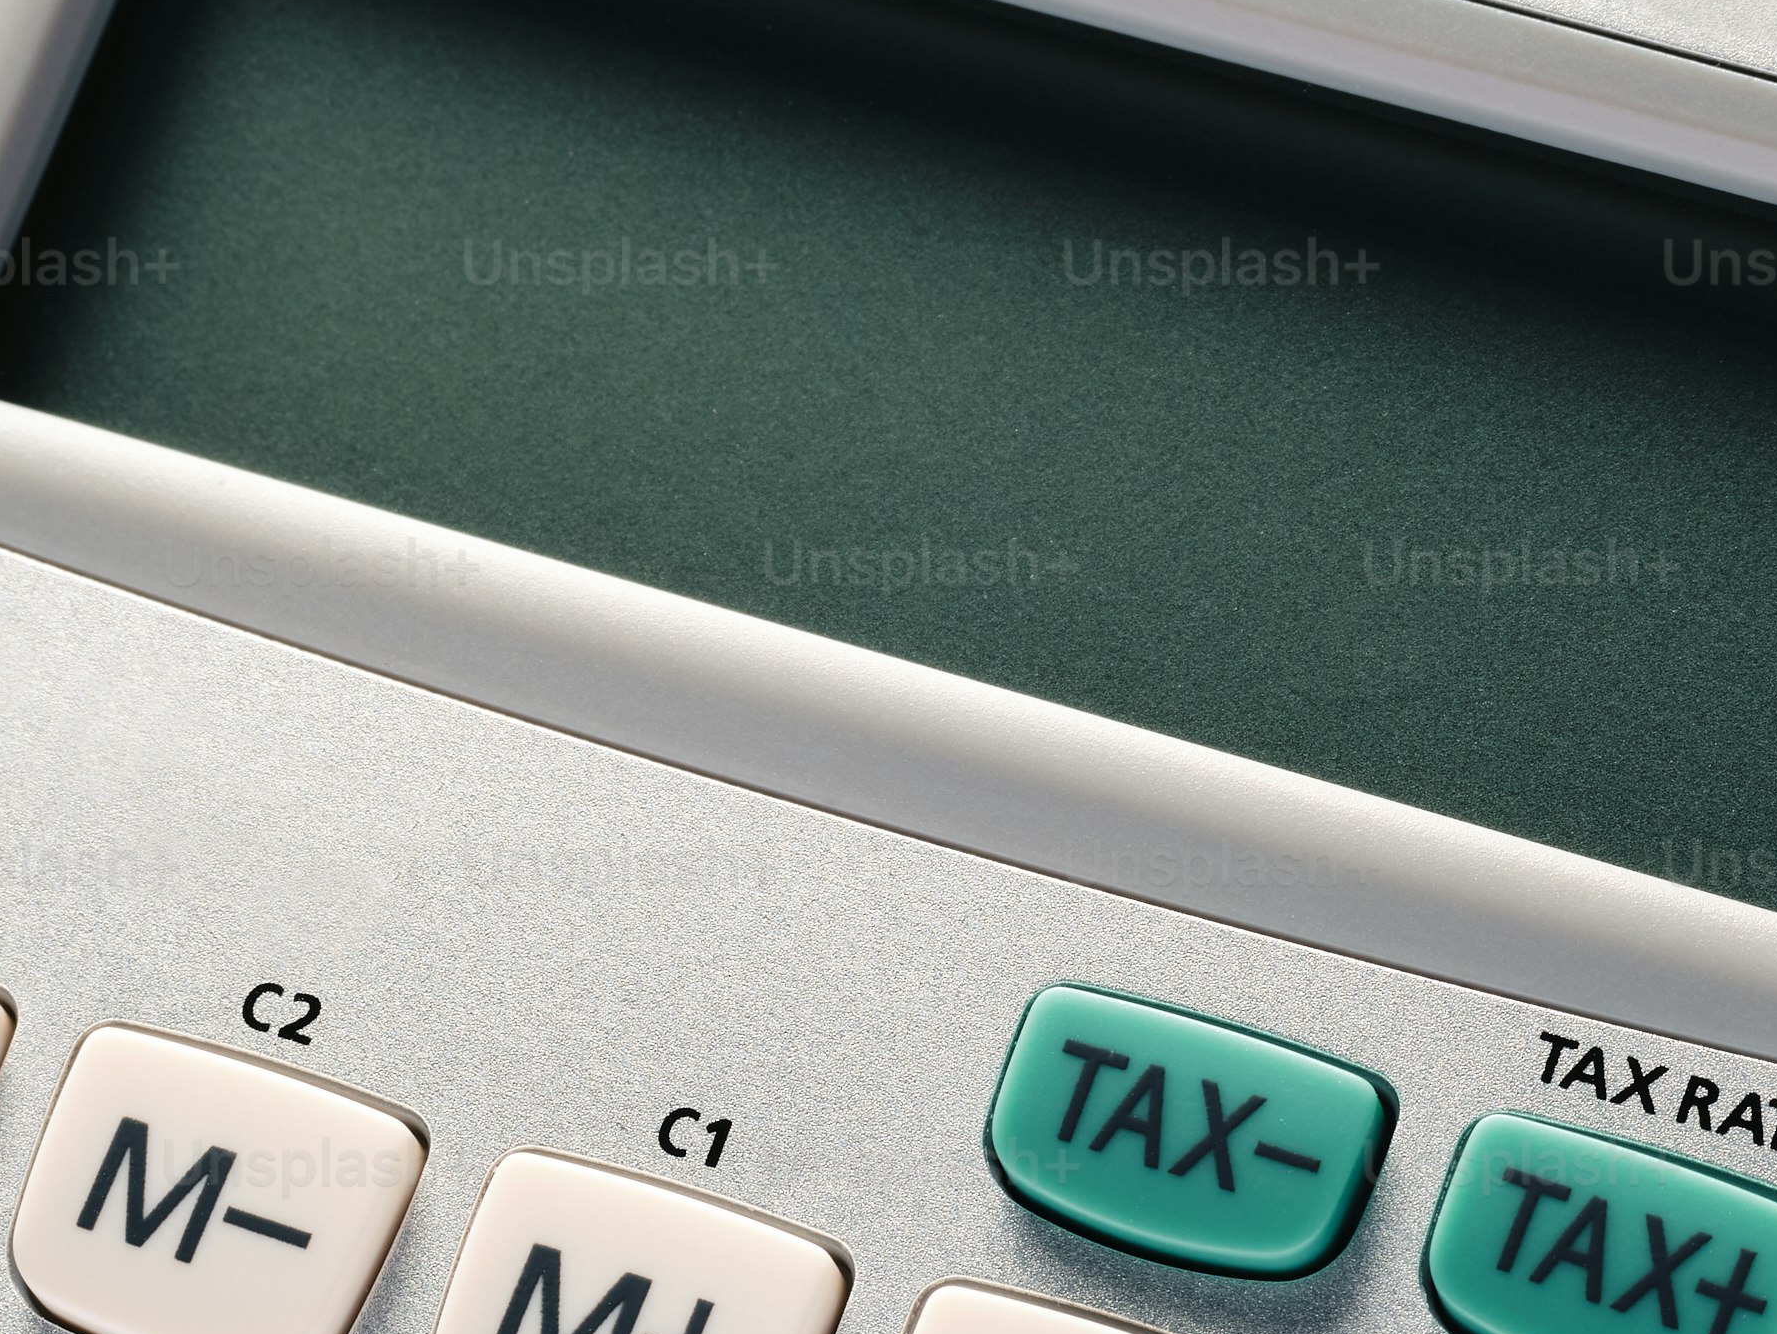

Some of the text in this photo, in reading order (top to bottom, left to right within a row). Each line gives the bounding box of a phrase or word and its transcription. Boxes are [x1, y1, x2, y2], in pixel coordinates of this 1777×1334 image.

[242, 982, 322, 1046] C2
[1539, 1031, 1668, 1115] TAX
[658, 1107, 733, 1168] C1
